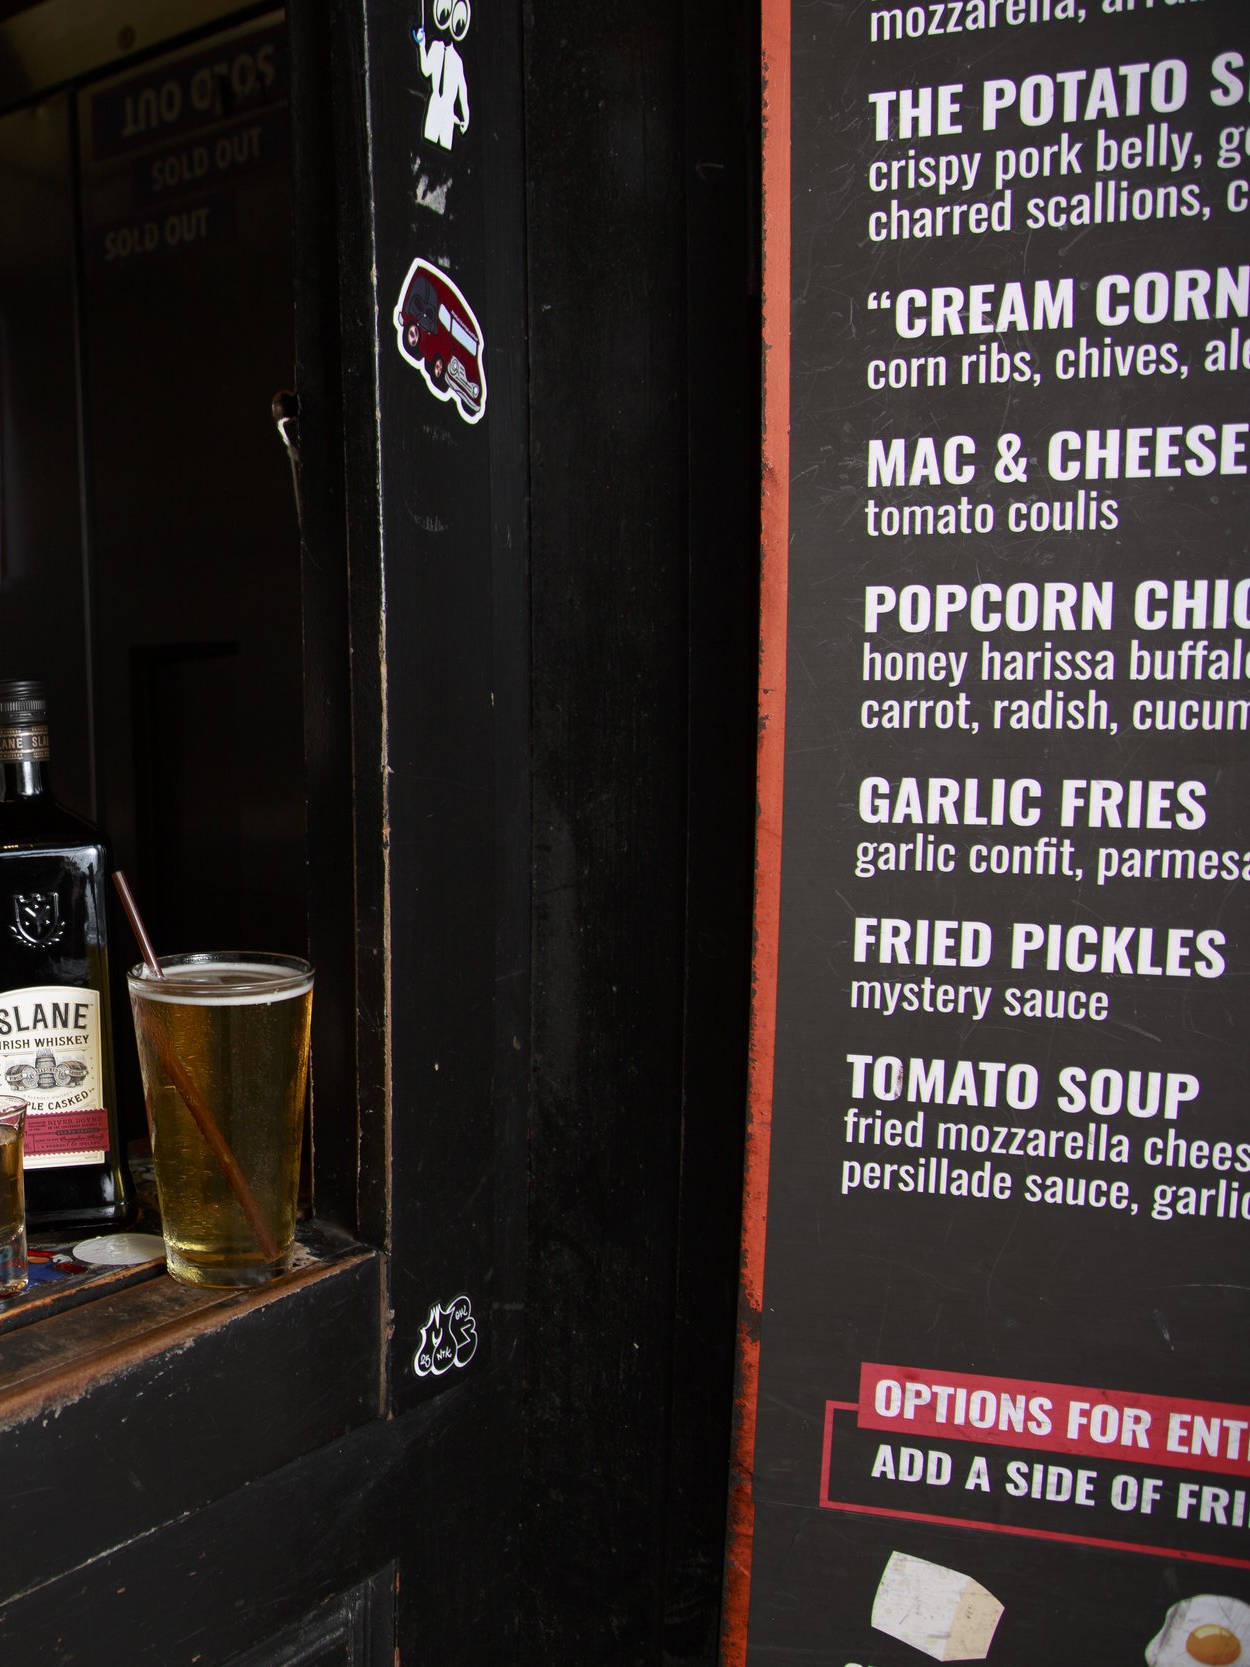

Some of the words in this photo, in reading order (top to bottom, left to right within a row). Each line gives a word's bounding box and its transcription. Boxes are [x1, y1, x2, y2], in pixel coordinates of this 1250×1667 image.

[190, 43, 276, 116] SOLD
[868, 83, 964, 142] THE
[982, 59, 1188, 131] POTATO
[121, 80, 183, 138] OUT
[152, 146, 209, 191] SOLD
[215, 126, 264, 168] OUT
[868, 149, 982, 196] crispy
[995, 132, 1083, 191] pork
[1096, 122, 1202, 172] belly,
[103, 222, 159, 262] SOLD
[165, 207, 211, 245] OUT
[868, 189, 1012, 242] charred
[1026, 179, 1211, 230] scallions,
[867, 355, 947, 390] corn
[961, 341, 1041, 388] ribs,
[1055, 336, 1189, 380] chives,
[867, 434, 976, 488] MAC
[994, 432, 1028, 484] &
[1047, 422, 1250, 482] CHEESE
[864, 496, 994, 537] tomato
[1008, 489, 1119, 533] coulis
[864, 581, 1114, 634] POPCORN
[862, 641, 969, 688] honey
[981, 640, 1115, 681] harissa
[1129, 638, 1250, 681] buffal
[860, 692, 979, 735] carrot,
[993, 689, 1118, 736] radish,
[858, 776, 1042, 827] GARLIC
[1060, 779, 1207, 831] FRIES
[854, 832, 956, 878] garlic
[969, 836, 1083, 882] confit,
[853, 916, 992, 968] FRIED
[1011, 922, 1226, 979] PICKLES
[850, 976, 993, 1021] mystery
[1003, 987, 1109, 1021] sauce
[34, 1034, 90, 1048] WHISKEY
[47, 1090, 90, 1111] CASKED
[846, 1053, 1039, 1110] TOMATO
[1057, 1066, 1200, 1120] SOUP
[843, 1107, 925, 1148] fried
[937, 1122, 1130, 1164] mozzarella
[841, 1156, 1012, 1200] persillade
[1024, 1174, 1139, 1216] sauce,
[874, 1378, 1053, 1436] OPTIONS
[1066, 1400, 1152, 1449] FOR
[1166, 1412, 1250, 1462] ENT
[870, 1444, 952, 1486] ADD
[964, 1455, 991, 1493] A
[1005, 1460, 1098, 1507] SIDE
[1110, 1474, 1163, 1514] OF
[1176, 1482, 1250, 1527] FRI
